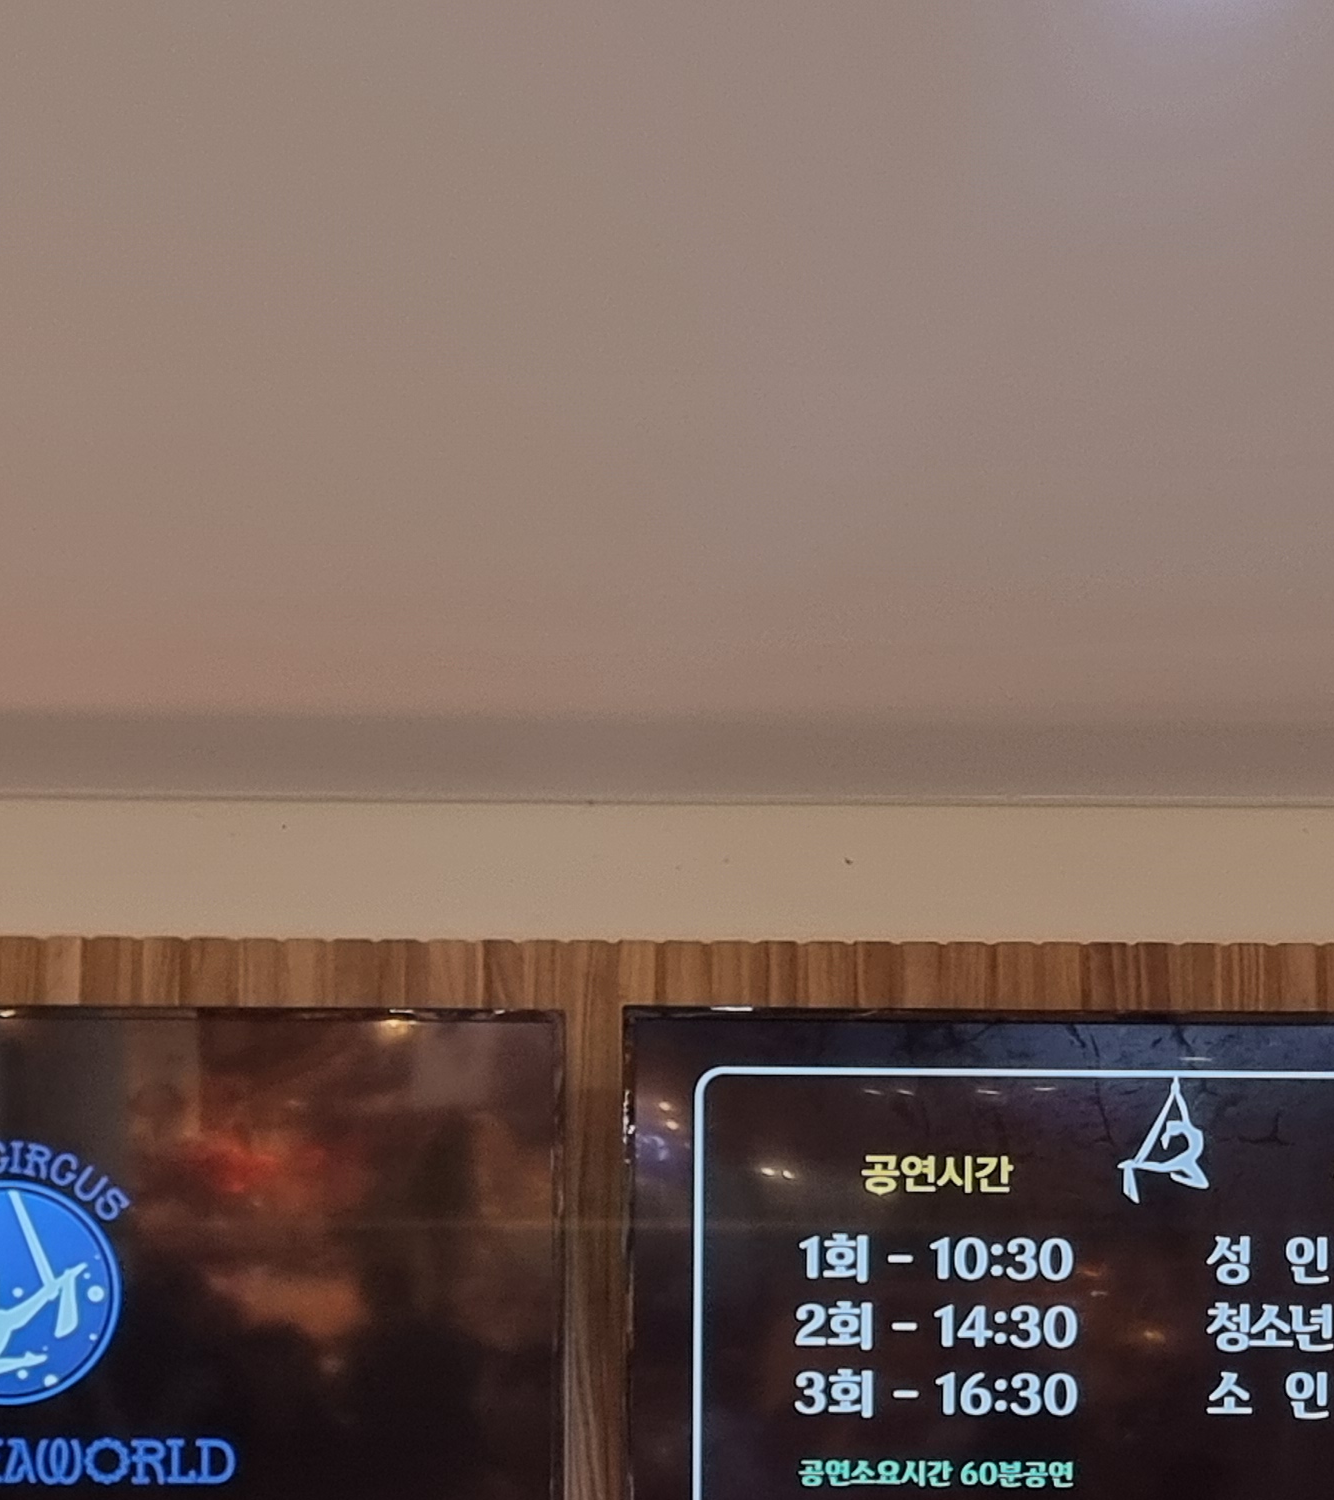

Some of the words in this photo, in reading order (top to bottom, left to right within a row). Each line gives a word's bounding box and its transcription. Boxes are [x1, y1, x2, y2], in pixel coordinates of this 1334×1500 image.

[861, 1153, 1014, 1196] 공연시간
[799, 1234, 871, 1283] 1회
[930, 1237, 1075, 1282] 10:30
[795, 1301, 873, 1350] 2회
[936, 1304, 1078, 1349] 14:30
[1205, 1302, 1334, 1353] 청소년
[795, 1369, 874, 1418] 3회
[936, 1371, 1078, 1417] 16:30
[798, 1459, 953, 1489] 공연소요시간
[960, 1459, 1074, 1488] 60분공연
